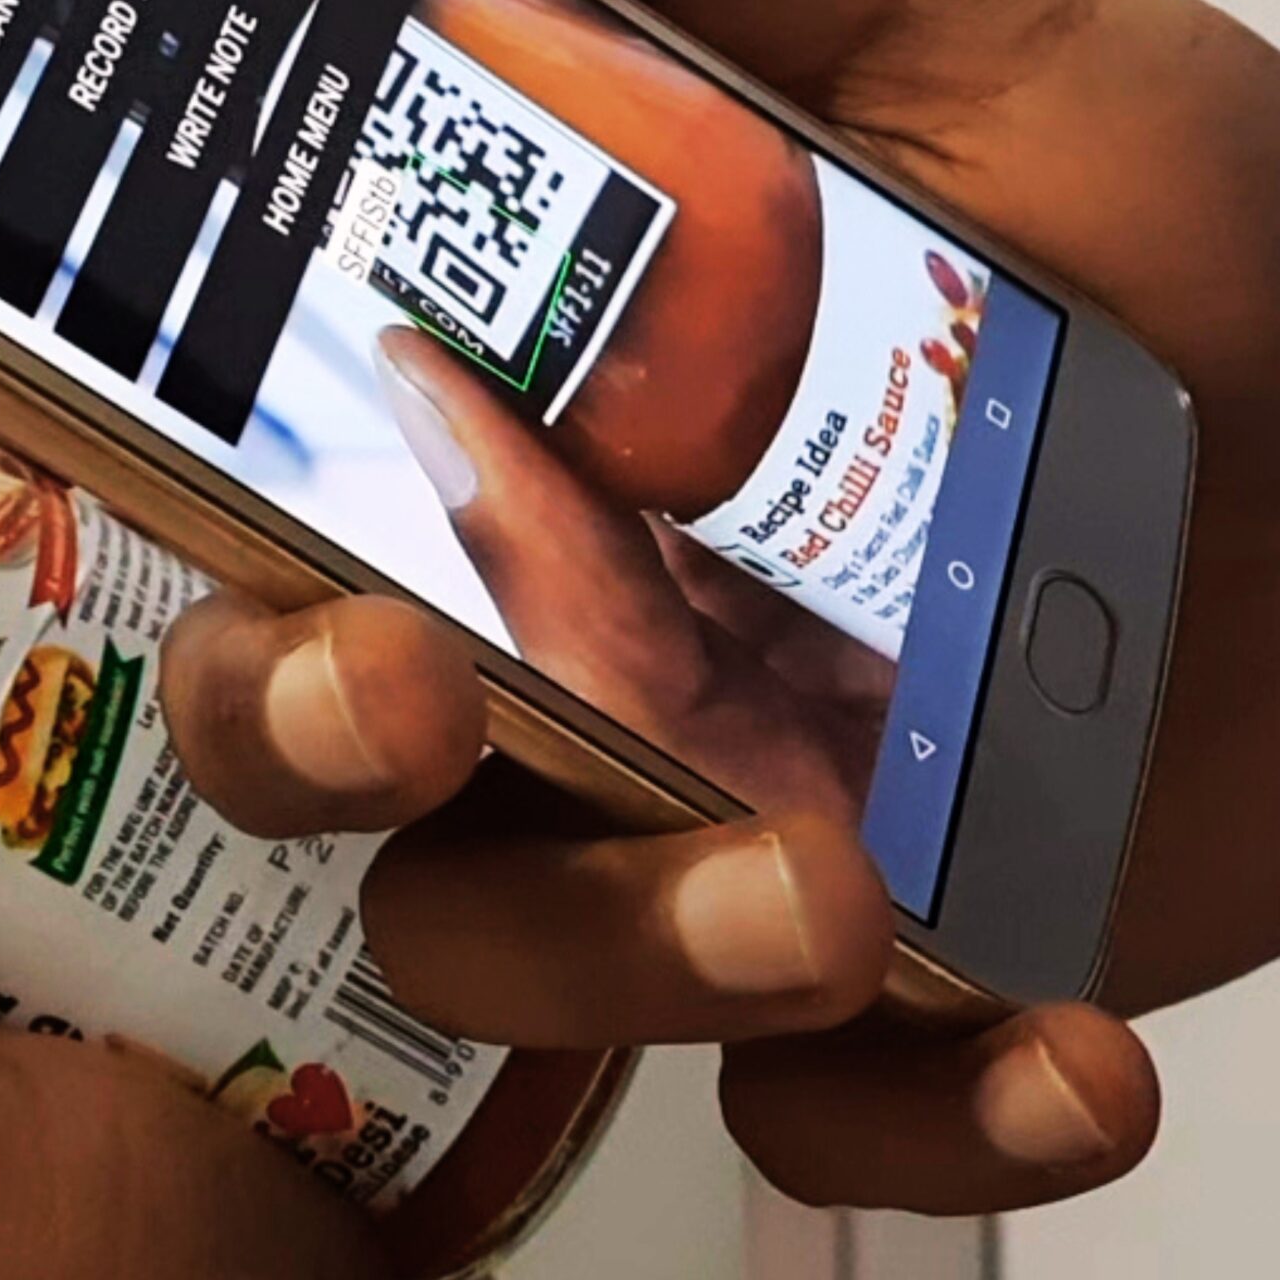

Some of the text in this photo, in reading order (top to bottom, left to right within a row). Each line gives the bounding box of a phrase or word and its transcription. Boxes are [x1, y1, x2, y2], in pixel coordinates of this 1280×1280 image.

[68, 0, 138, 112] RECORD
[166, 4, 258, 171] WRITE NOTE
[261, 63, 350, 236] HOME MENU
[548, 248, 612, 347] SFF1-11
[740, 409, 848, 544] Recipe Idea
[780, 345, 911, 570] Red Chilli Sauce
[83, 874, 106, 901] FOR
[101, 844, 123, 871] THE
[100, 893, 118, 912] OF
[112, 863, 133, 890] THE
[130, 818, 162, 865] BATCH
[117, 874, 157, 922] BEFORE
[149, 845, 173, 870] THE
[152, 910, 181, 944] Net
[192, 916, 230, 967] BATCH
[222, 922, 264, 983] DATE OF
[315, 1102, 408, 1187] Desi
